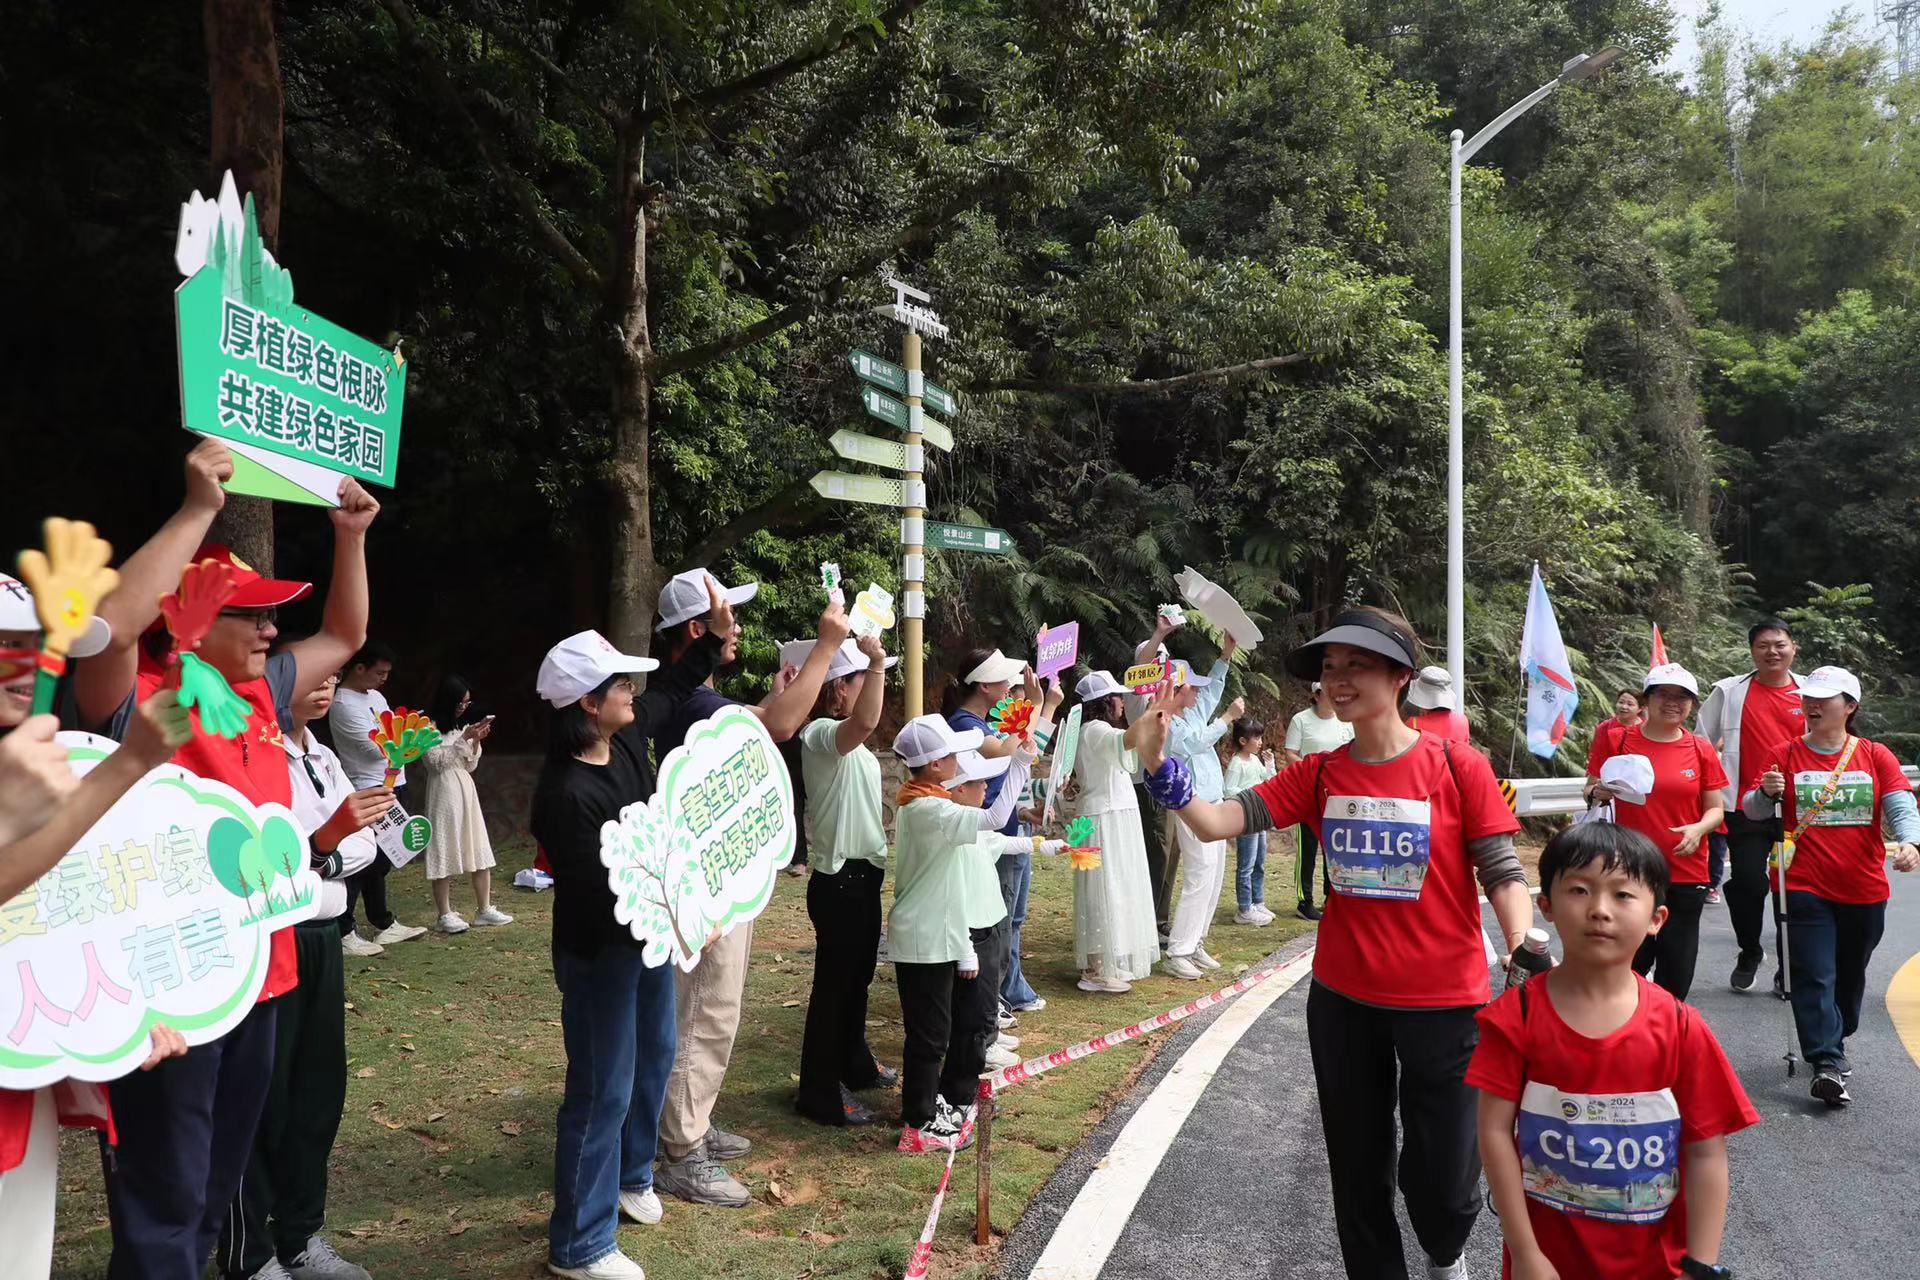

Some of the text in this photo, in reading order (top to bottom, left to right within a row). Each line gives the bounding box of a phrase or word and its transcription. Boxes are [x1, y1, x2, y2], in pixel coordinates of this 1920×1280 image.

[220, 299, 387, 413] 厚植绿色根脉
[219, 371, 384, 473] 共建绿色家园
[943, 528, 973, 540] 悦景山庄
[680, 739, 769, 838] 春生万物
[410, 822, 425, 849] skill
[700, 787, 785, 897] 护绿先行
[1331, 827, 1415, 857] CL116
[7, 909, 235, 1046] 人人有责
[1610, 1097, 1635, 1106] 2024
[1539, 1129, 1666, 1170] CL208
